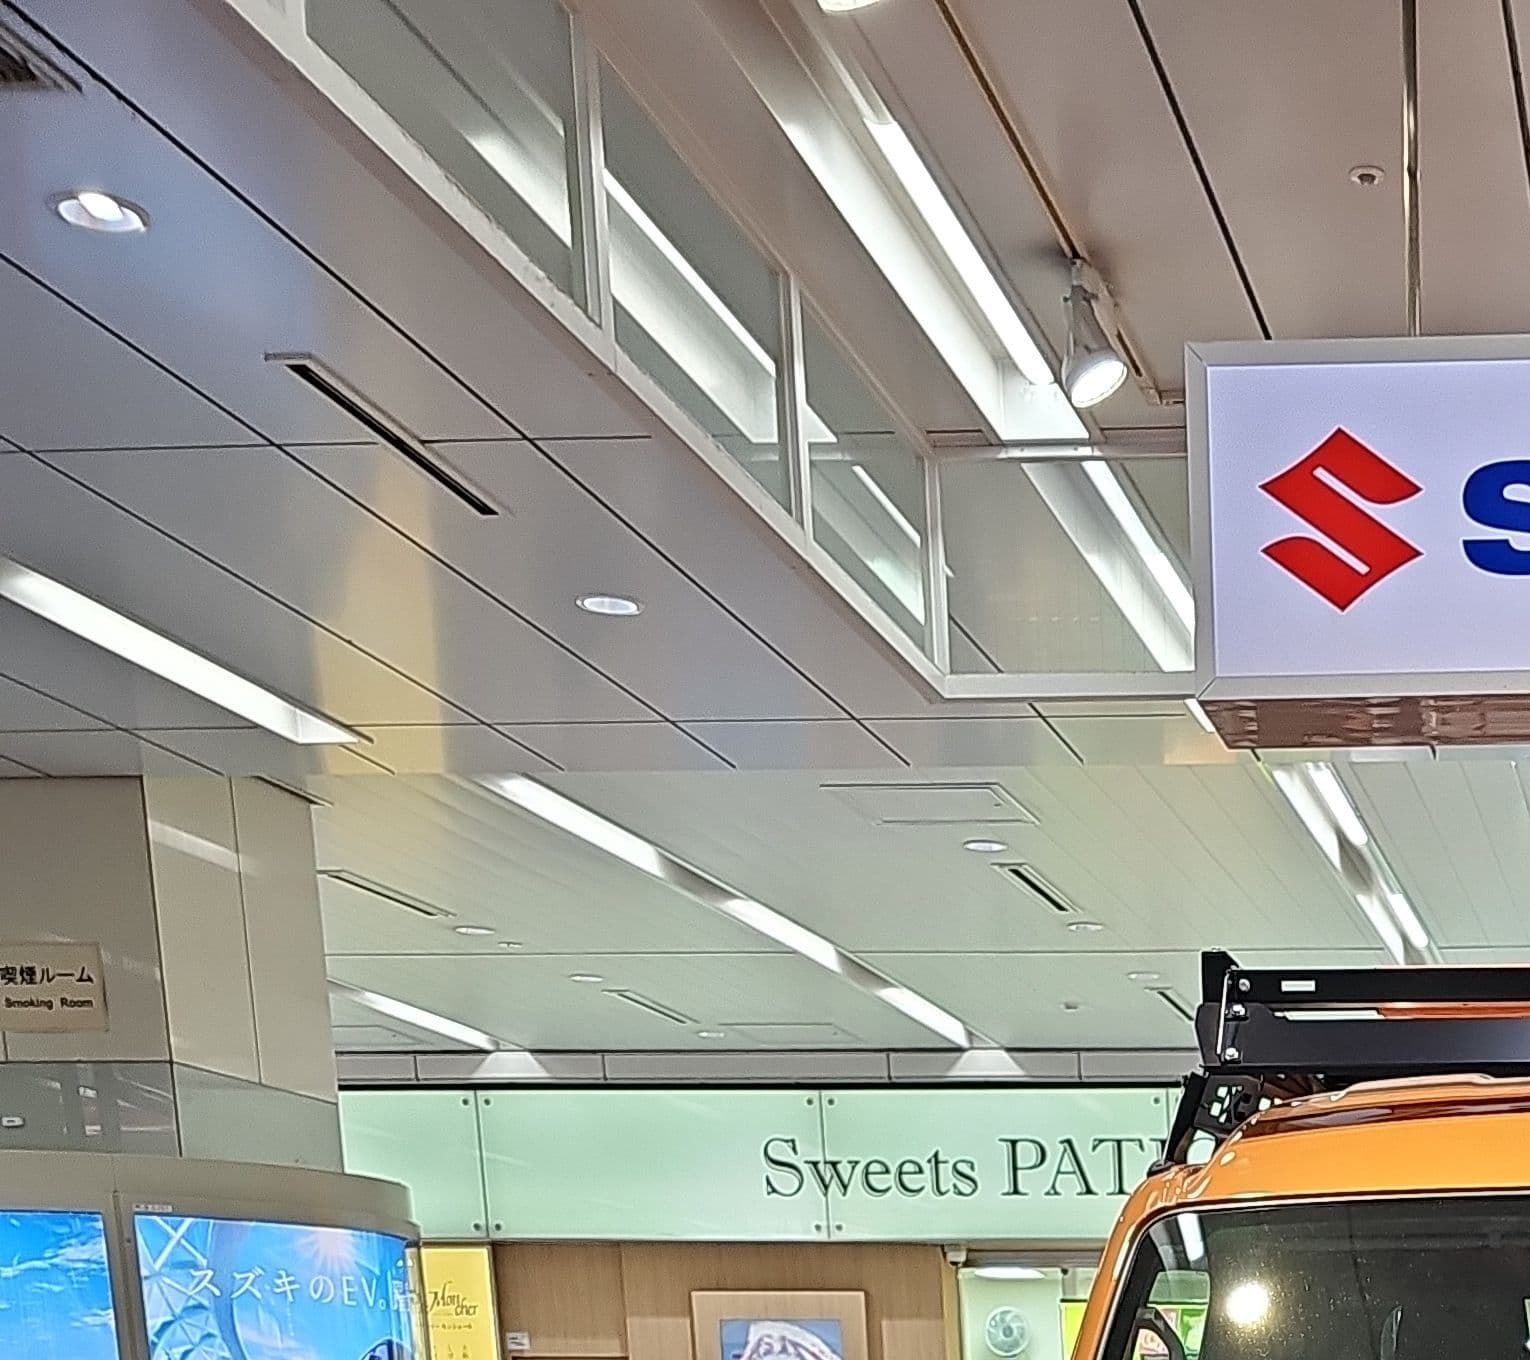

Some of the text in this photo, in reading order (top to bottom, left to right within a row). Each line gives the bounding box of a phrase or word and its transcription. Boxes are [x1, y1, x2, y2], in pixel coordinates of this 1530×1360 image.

[5, 997, 93, 1010] Smoking Room
[763, 1137, 979, 1198] Sweets
